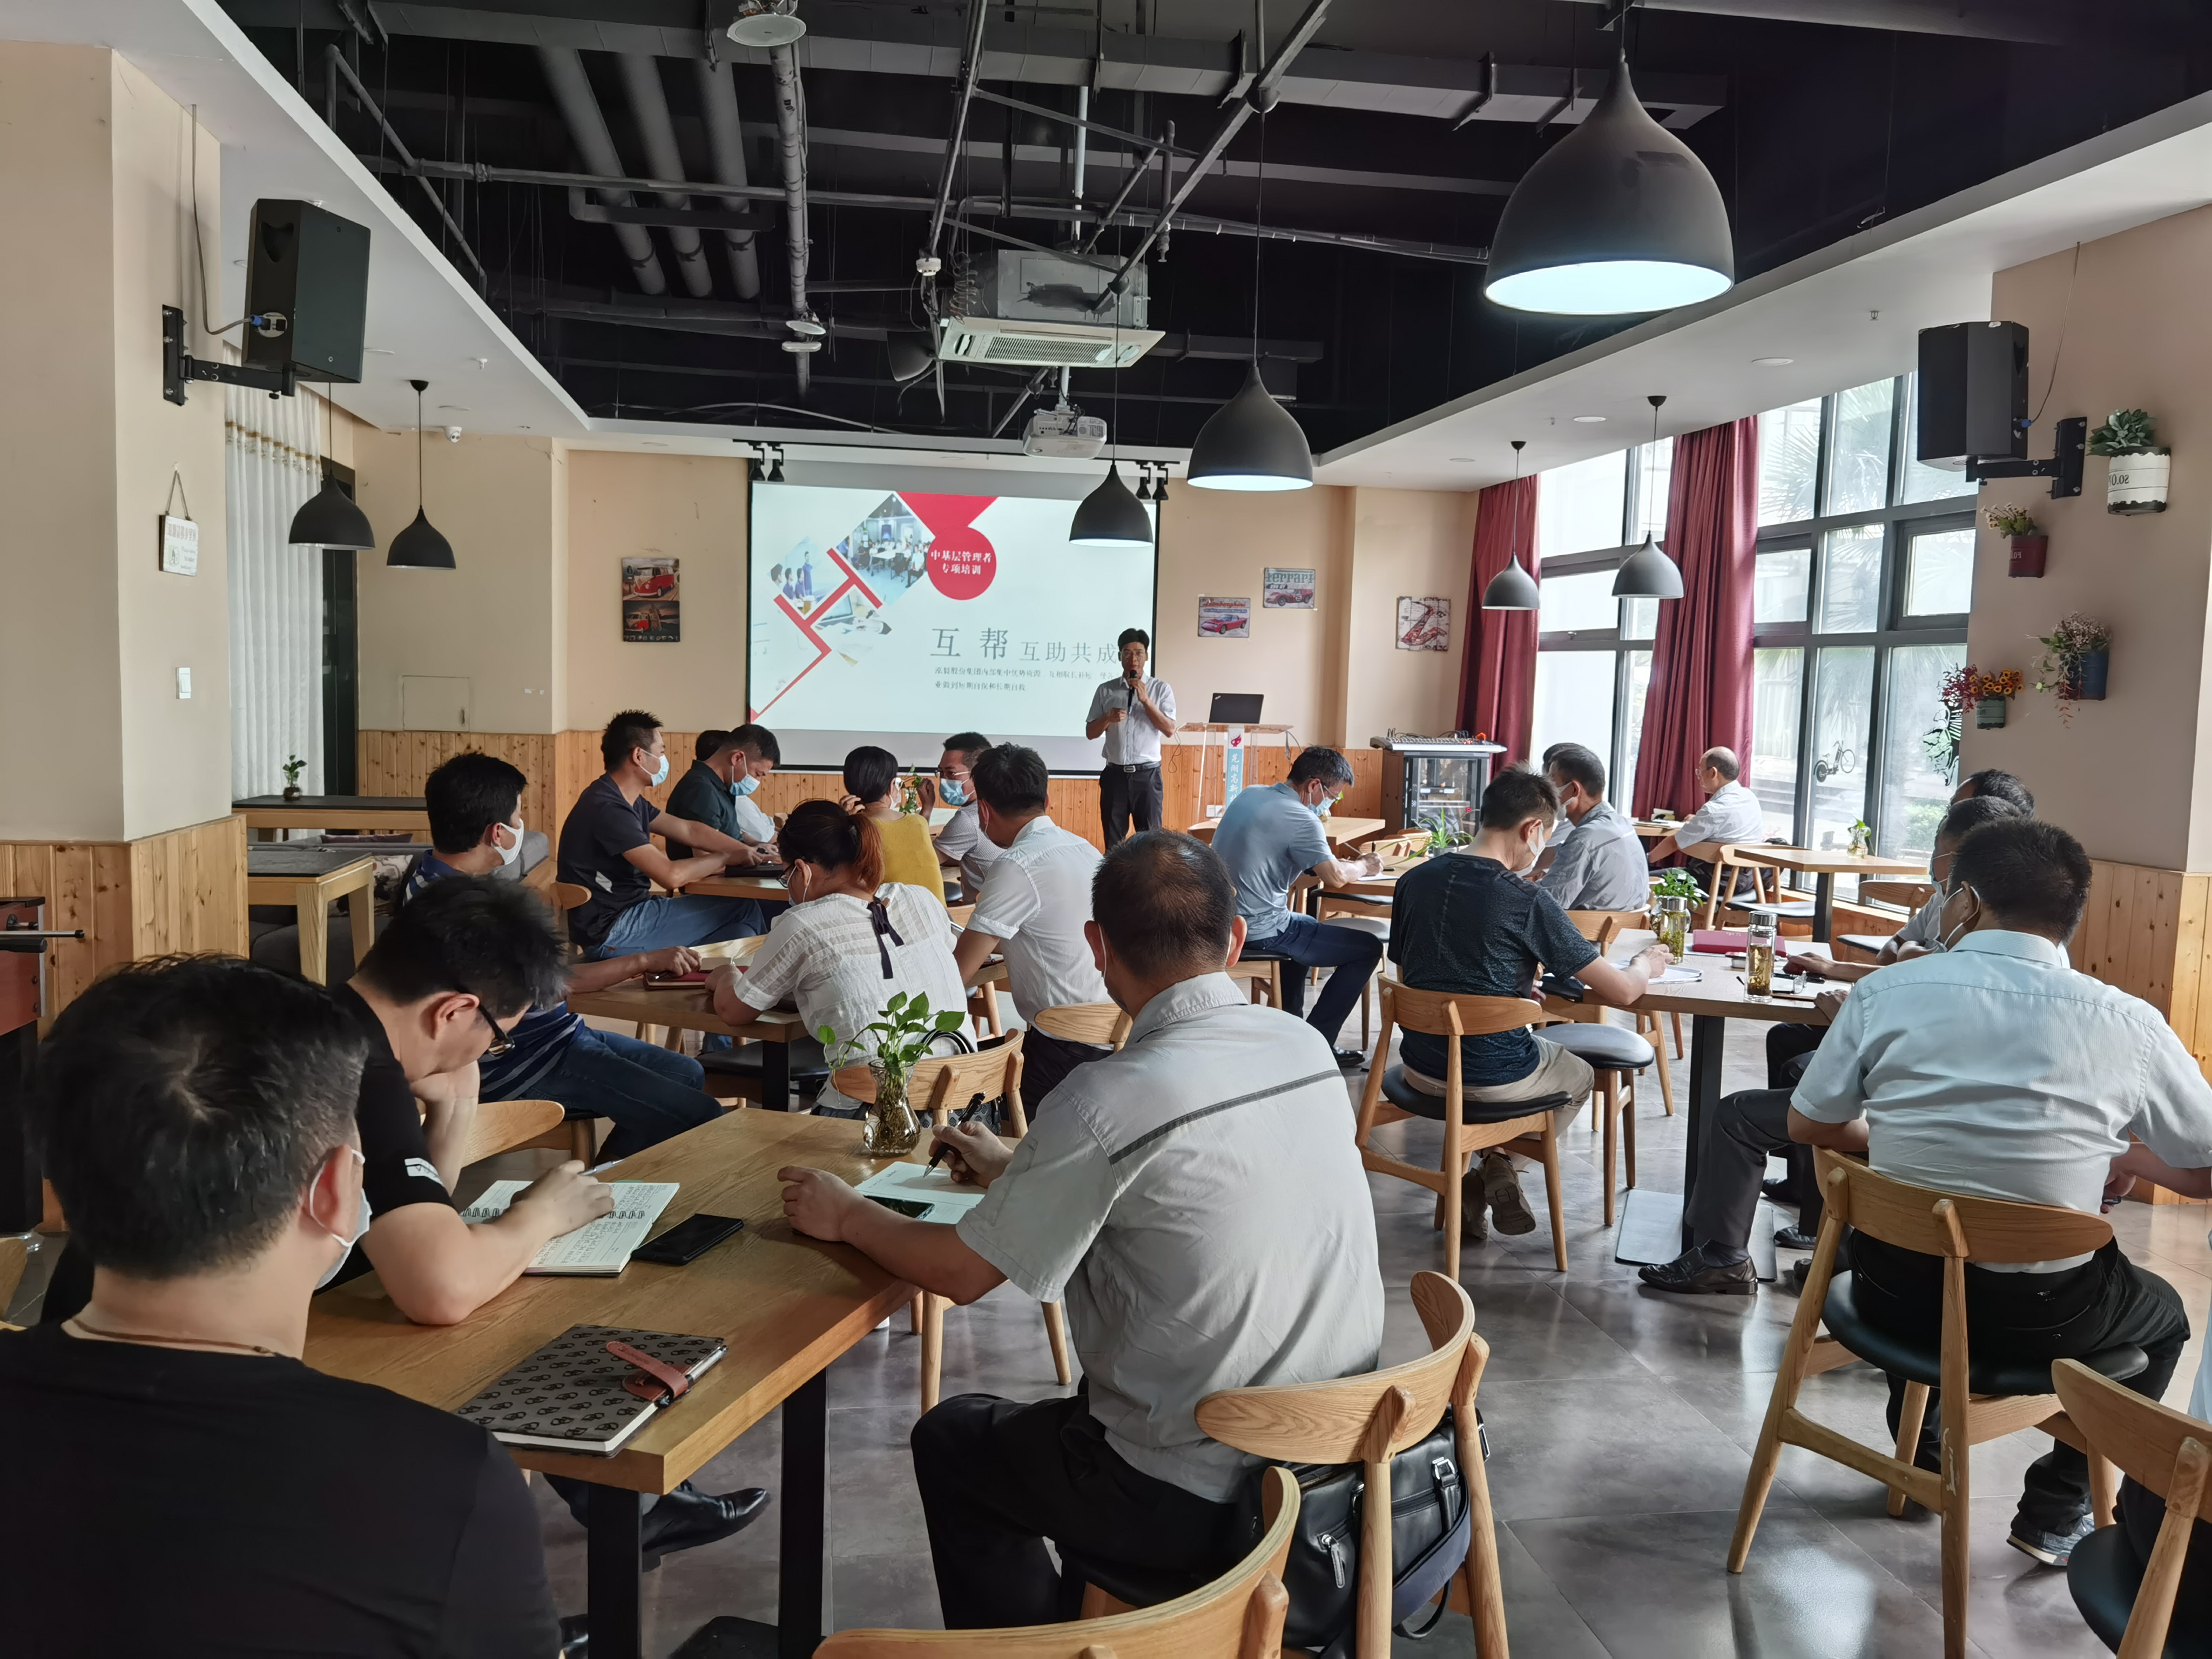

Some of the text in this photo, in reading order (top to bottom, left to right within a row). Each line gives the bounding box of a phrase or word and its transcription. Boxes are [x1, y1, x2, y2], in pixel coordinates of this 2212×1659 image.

[930, 549, 992, 563] 中基层管理者
[942, 563, 981, 575] 专项培训
